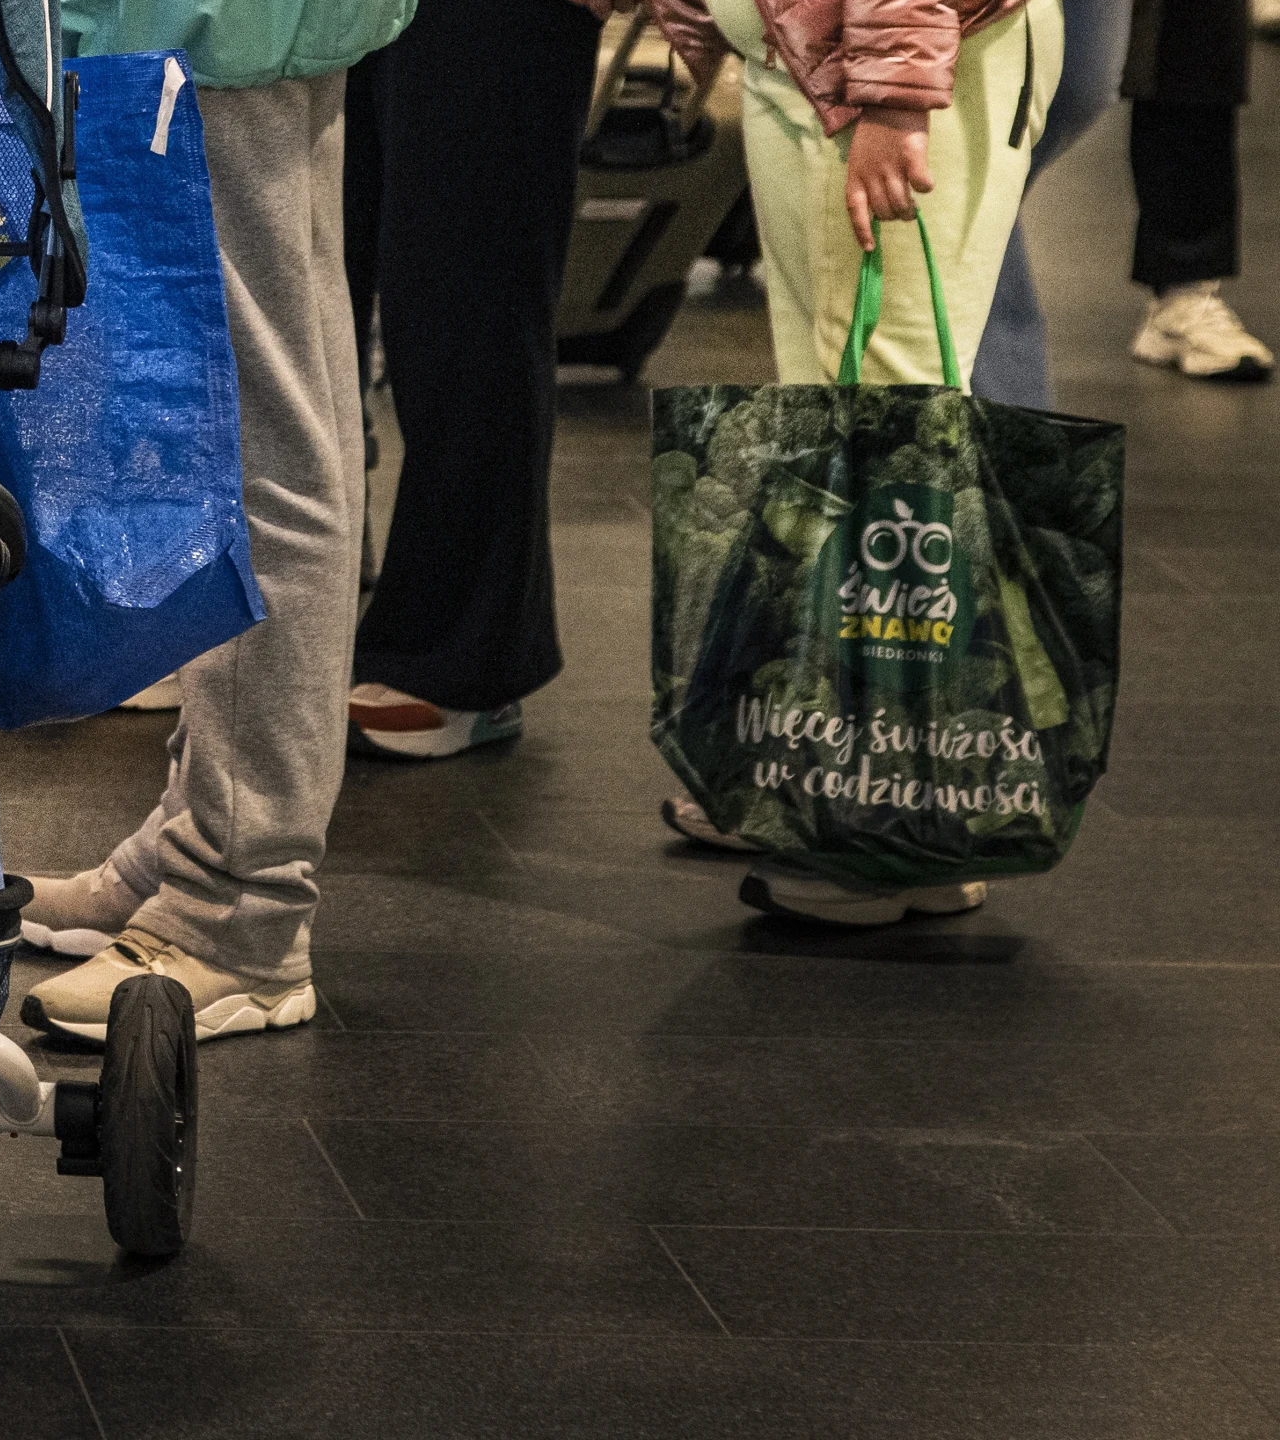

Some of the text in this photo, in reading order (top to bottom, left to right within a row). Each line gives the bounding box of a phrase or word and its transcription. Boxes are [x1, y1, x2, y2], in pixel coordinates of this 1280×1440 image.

[737, 691, 864, 765] Więcej
[754, 753, 1047, 817] w codzienności
